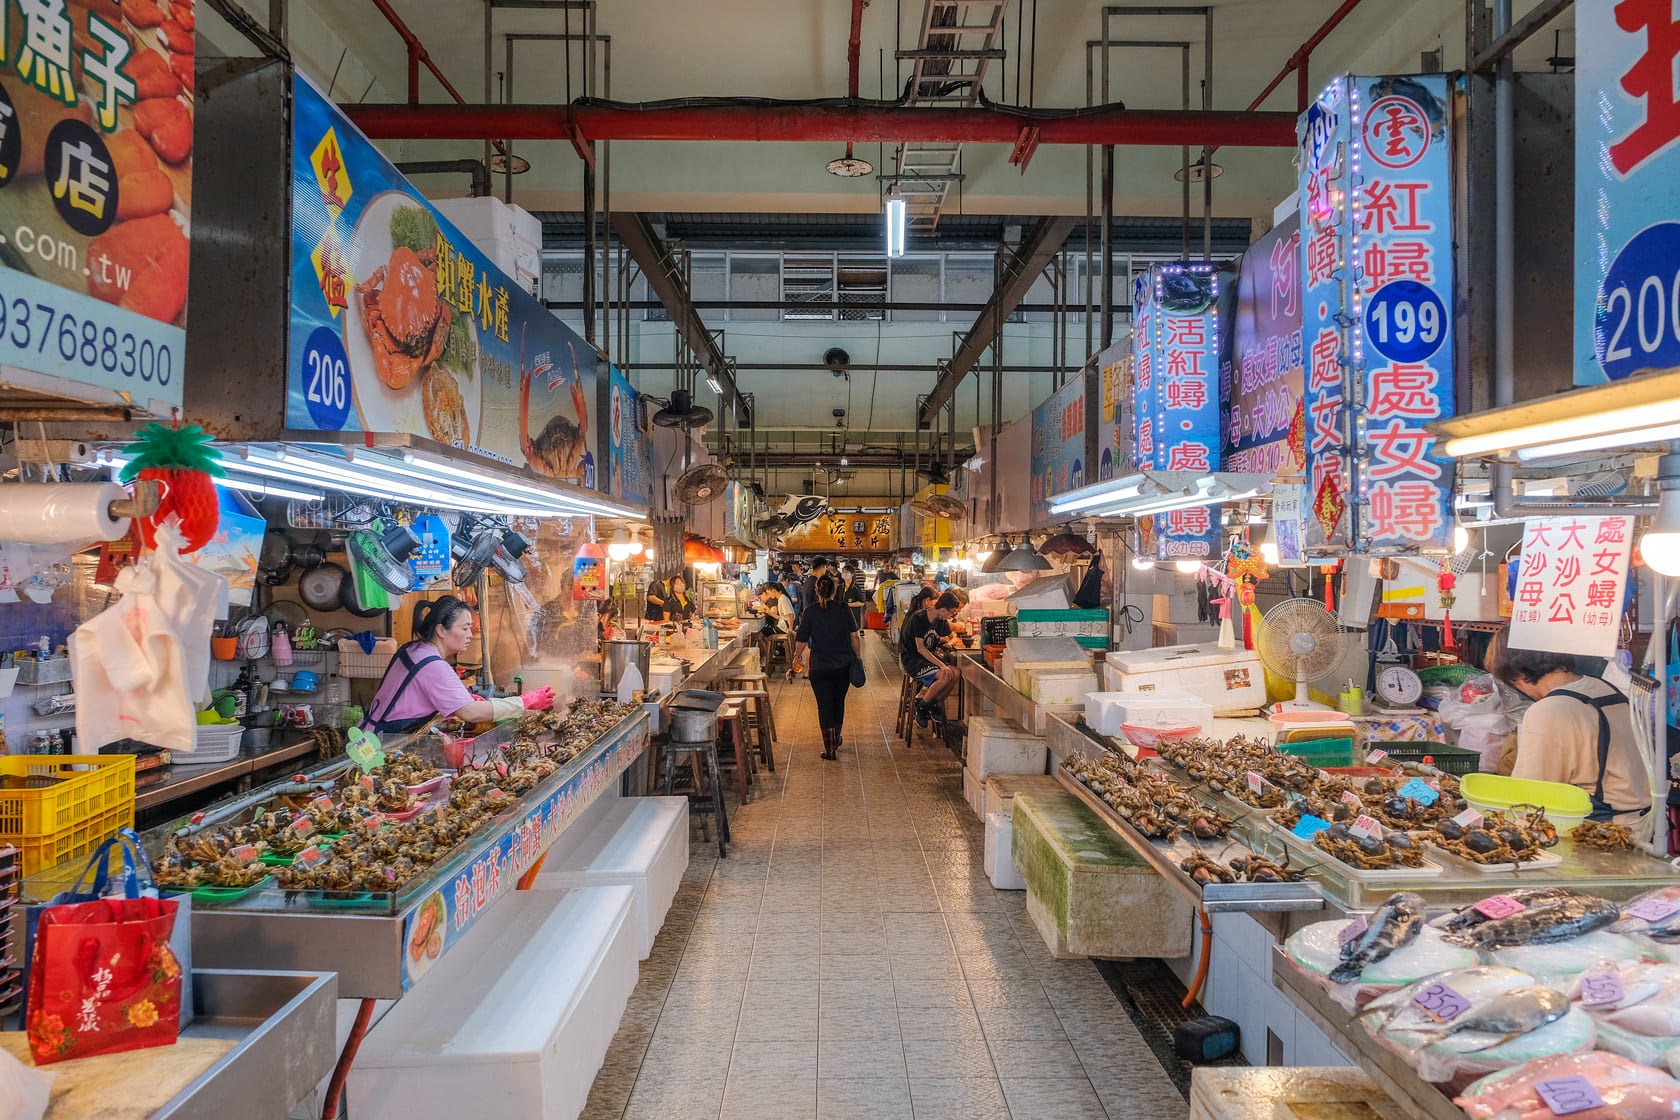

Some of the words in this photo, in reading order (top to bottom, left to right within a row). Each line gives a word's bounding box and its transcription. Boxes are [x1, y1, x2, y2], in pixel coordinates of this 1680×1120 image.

[1372, 107, 1418, 158] 雲
[54, 140, 110, 220] 店
[1363, 180, 1432, 295] 紅蟳
[436, 231, 510, 343] 鉅蟹水產
[1371, 300, 1440, 344] 199
[0, 297, 172, 387] 37688300
[307, 350, 346, 411] 206
[1368, 364, 1440, 537] 處女蟳
[1168, 541, 1210, 556] (幼母)
[1519, 522, 1552, 607] 大沙母
[1548, 519, 1587, 625] 大沙公
[1585, 516, 1626, 609] 處女蟳
[1582, 611, 1613, 626] (幼母)
[1355, 818, 1375, 830] 900
[1415, 983, 1460, 1018] 350
[1545, 1079, 1595, 1113] 400
